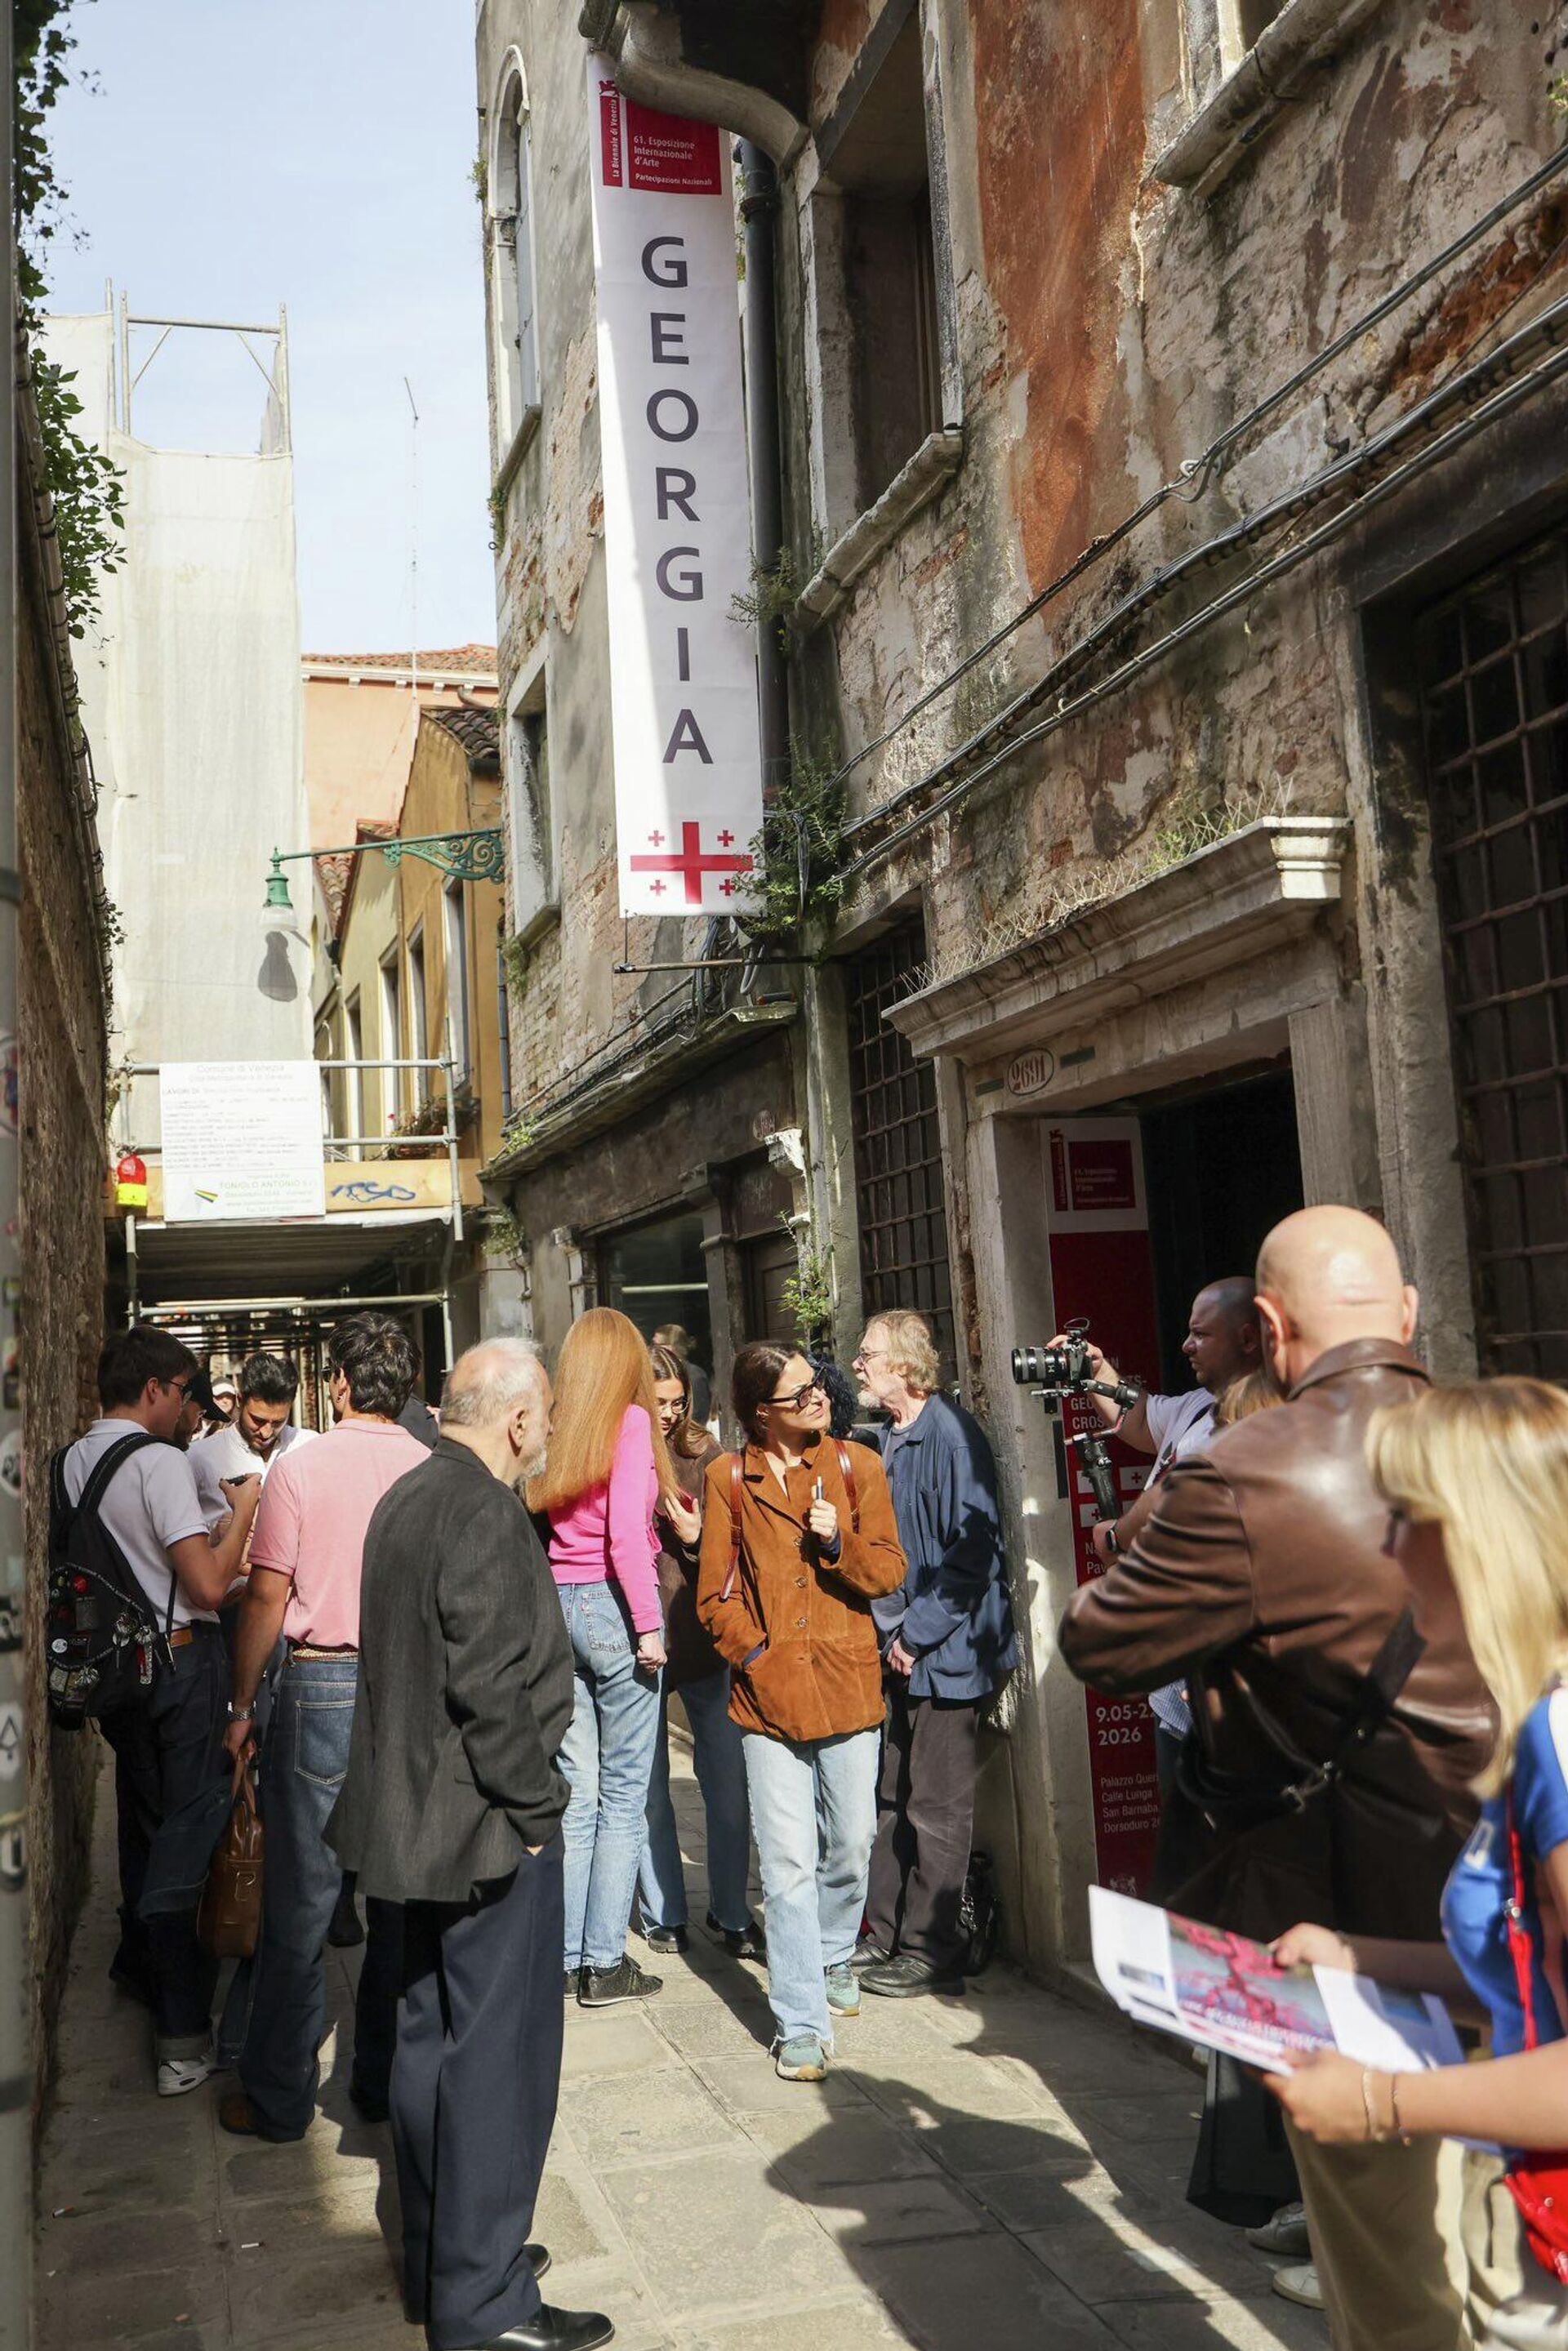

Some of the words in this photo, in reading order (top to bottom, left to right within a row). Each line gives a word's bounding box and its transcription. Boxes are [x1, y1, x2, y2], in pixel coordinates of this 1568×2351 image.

[634, 136, 646, 145] 61.
[648, 136, 695, 149] Esposizione
[634, 146, 693, 161] Internazionale
[635, 156, 660, 167] d'Arte
[635, 172, 681, 185] Partecipazioni
[682, 177, 712, 186] Nazionali
[641, 236, 713, 765] GEORGIA
[1098, 1726, 1143, 1746] 2026
[1100, 1776, 1134, 1788] Palazzo
[1102, 1791, 1124, 1803] Calle
[1125, 1788, 1153, 1801] Lunga
[1102, 1806, 1120, 1818] San
[1104, 1820, 1149, 1834] Dorsoduro
